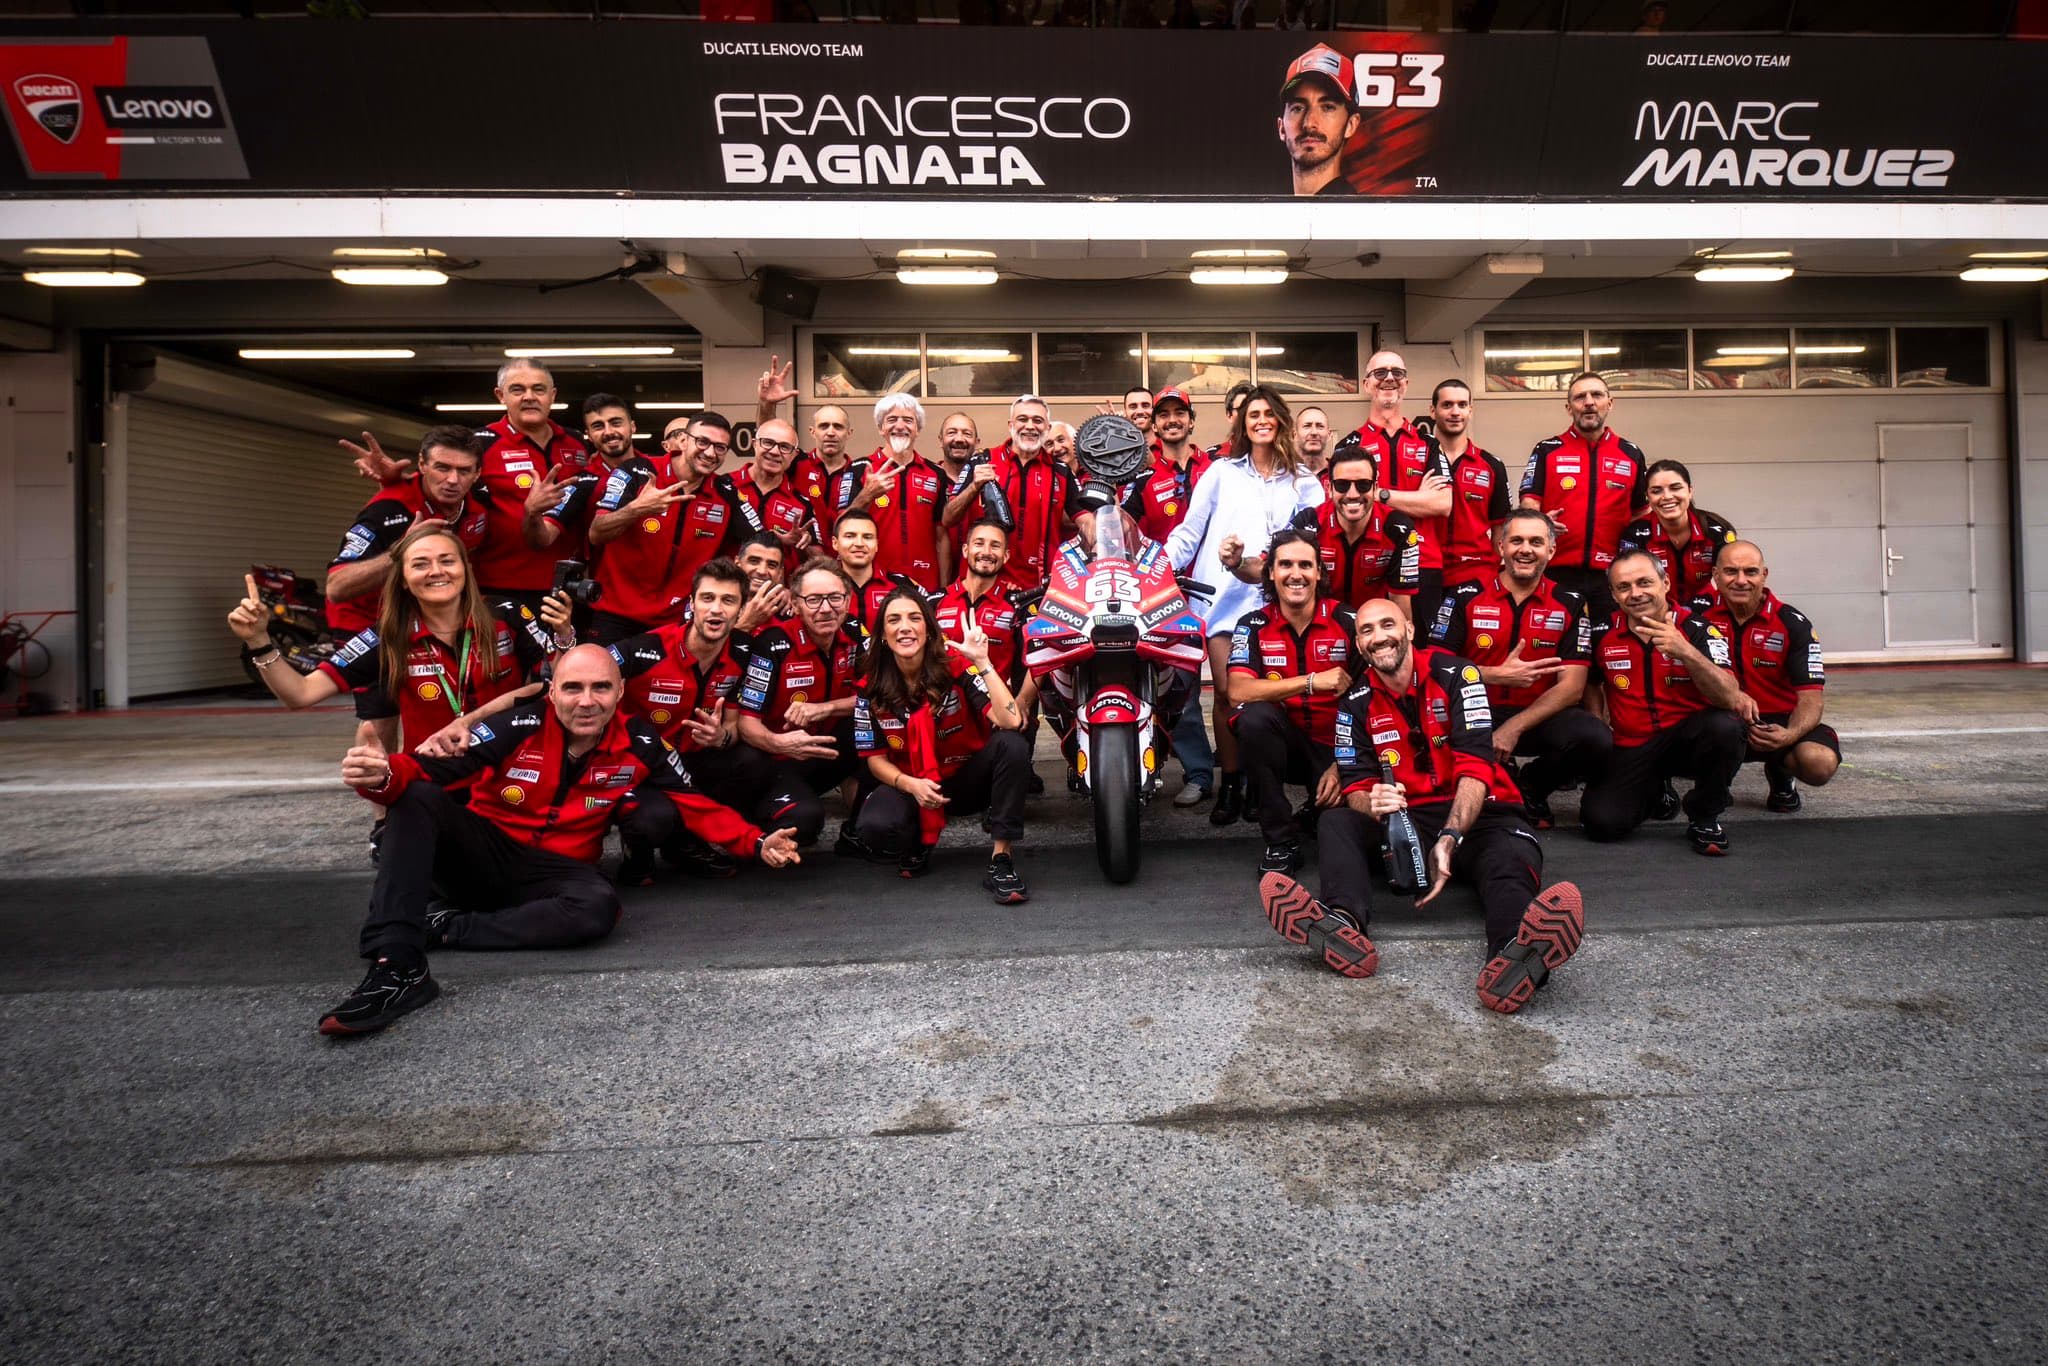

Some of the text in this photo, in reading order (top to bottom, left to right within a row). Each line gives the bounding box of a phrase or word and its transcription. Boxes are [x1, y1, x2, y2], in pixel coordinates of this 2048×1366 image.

[703, 42, 863, 57] DUCATI LENOVO TEAM
[1647, 54, 1791, 67] DUCATI LENOVO TEAM
[1354, 53, 1445, 108] 63
[22, 84, 74, 97] DUCATI
[106, 95, 213, 119] Lenovo
[714, 93, 1131, 139] FRANCESCO
[1634, 101, 1819, 141] MARC
[156, 136, 223, 145] FACTORY TEAM
[720, 143, 1046, 186] BAGNAIA
[1415, 177, 1438, 188] ITA
[1085, 569, 1141, 603] 63
[1043, 600, 1083, 627] Lenovo
[1143, 600, 1184, 625] Lenovo
[1041, 626, 1059, 634] TIM
[1180, 623, 1198, 631] TIM
[361, 630, 376, 643] TIM
[757, 659, 770, 668] TIM
[658, 694, 679, 703] riello
[1091, 698, 1133, 713] Lenovo
[476, 724, 490, 738] TIM
[1411, 846, 1428, 887] Castaldi
